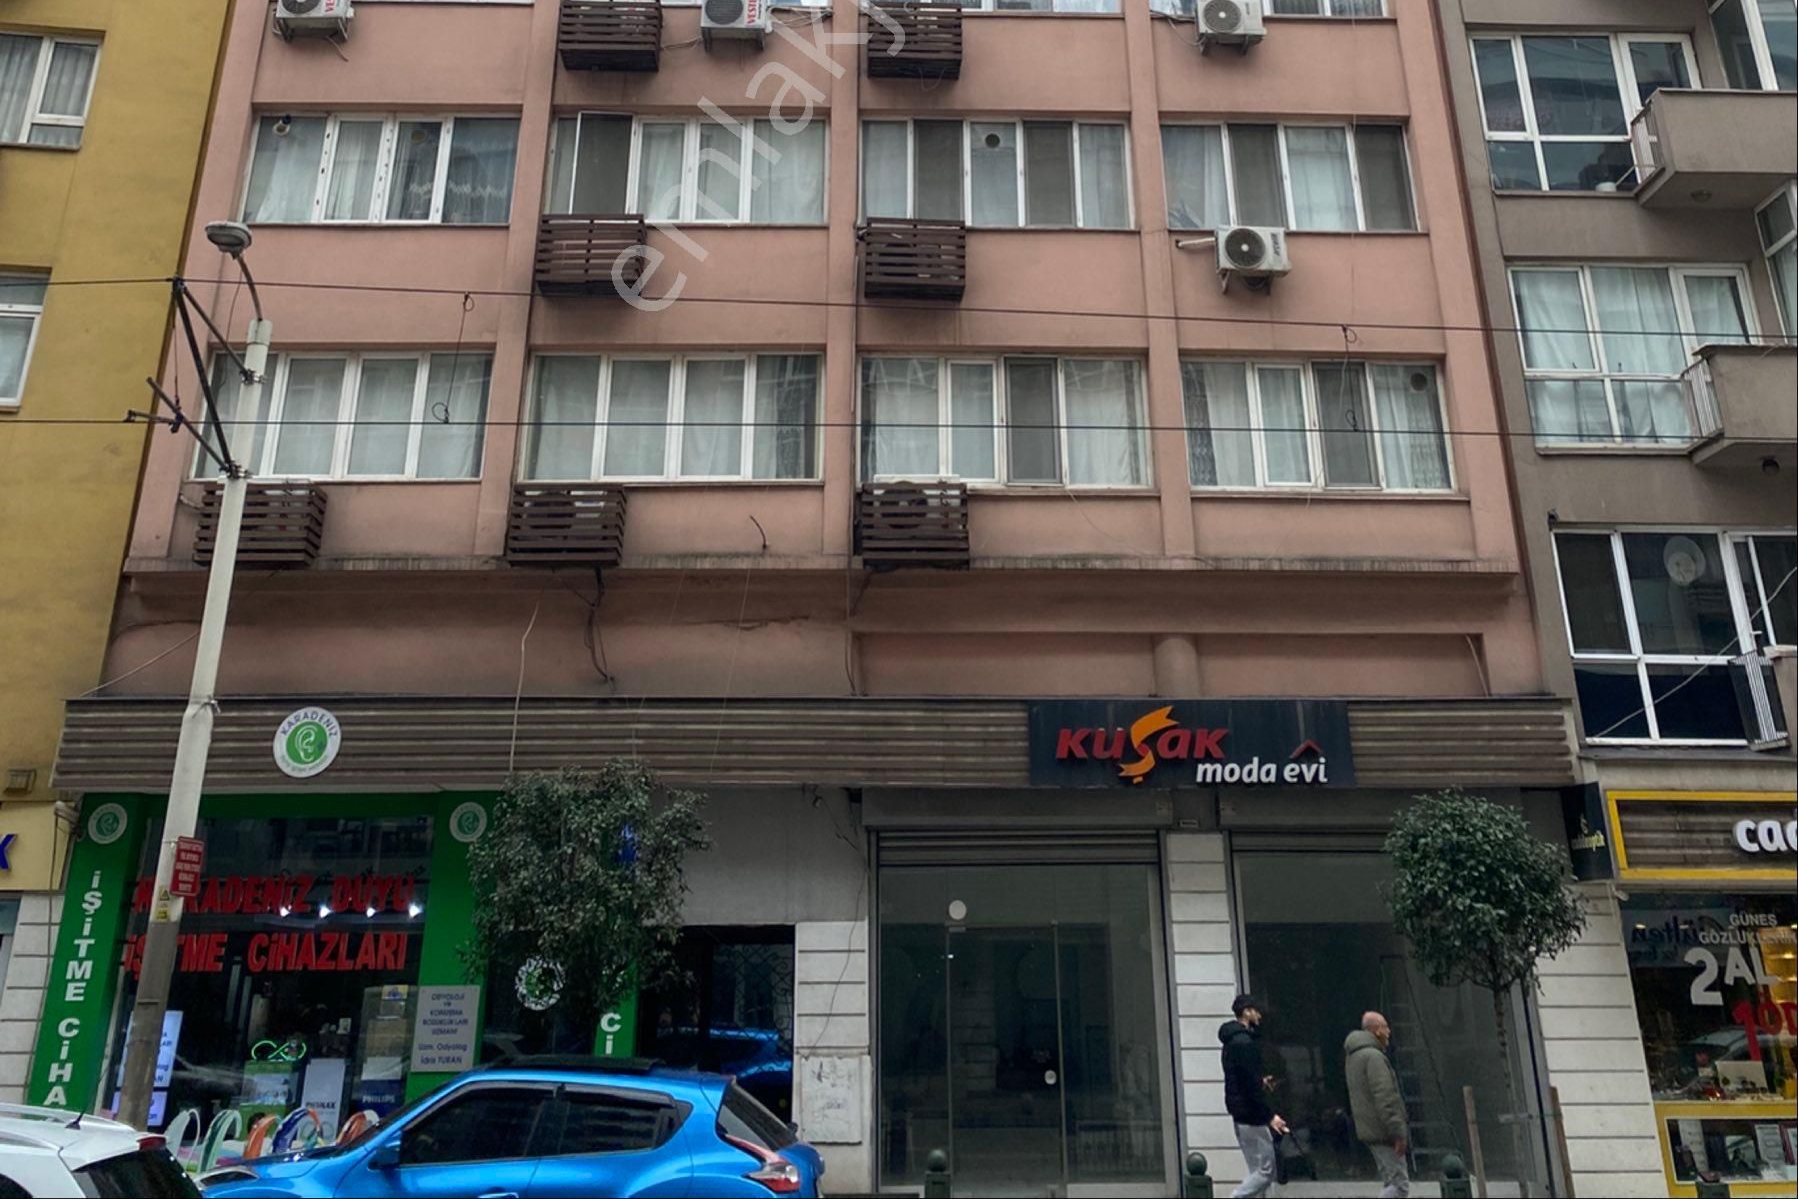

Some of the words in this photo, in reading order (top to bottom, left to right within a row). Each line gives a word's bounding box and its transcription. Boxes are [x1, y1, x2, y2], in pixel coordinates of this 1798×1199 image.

[281, 711, 338, 736] KARADENİZ
[1196, 757, 1276, 783] moda
[1283, 758, 1328, 783] evi
[331, 874, 414, 914] DUYU
[1729, 909, 1777, 928] GÜNEŞ
[123, 933, 227, 980] İŞME
[247, 931, 407, 973] CİHAZLARI
[1684, 947, 1724, 1006] 2
[1724, 945, 1779, 986] AL
